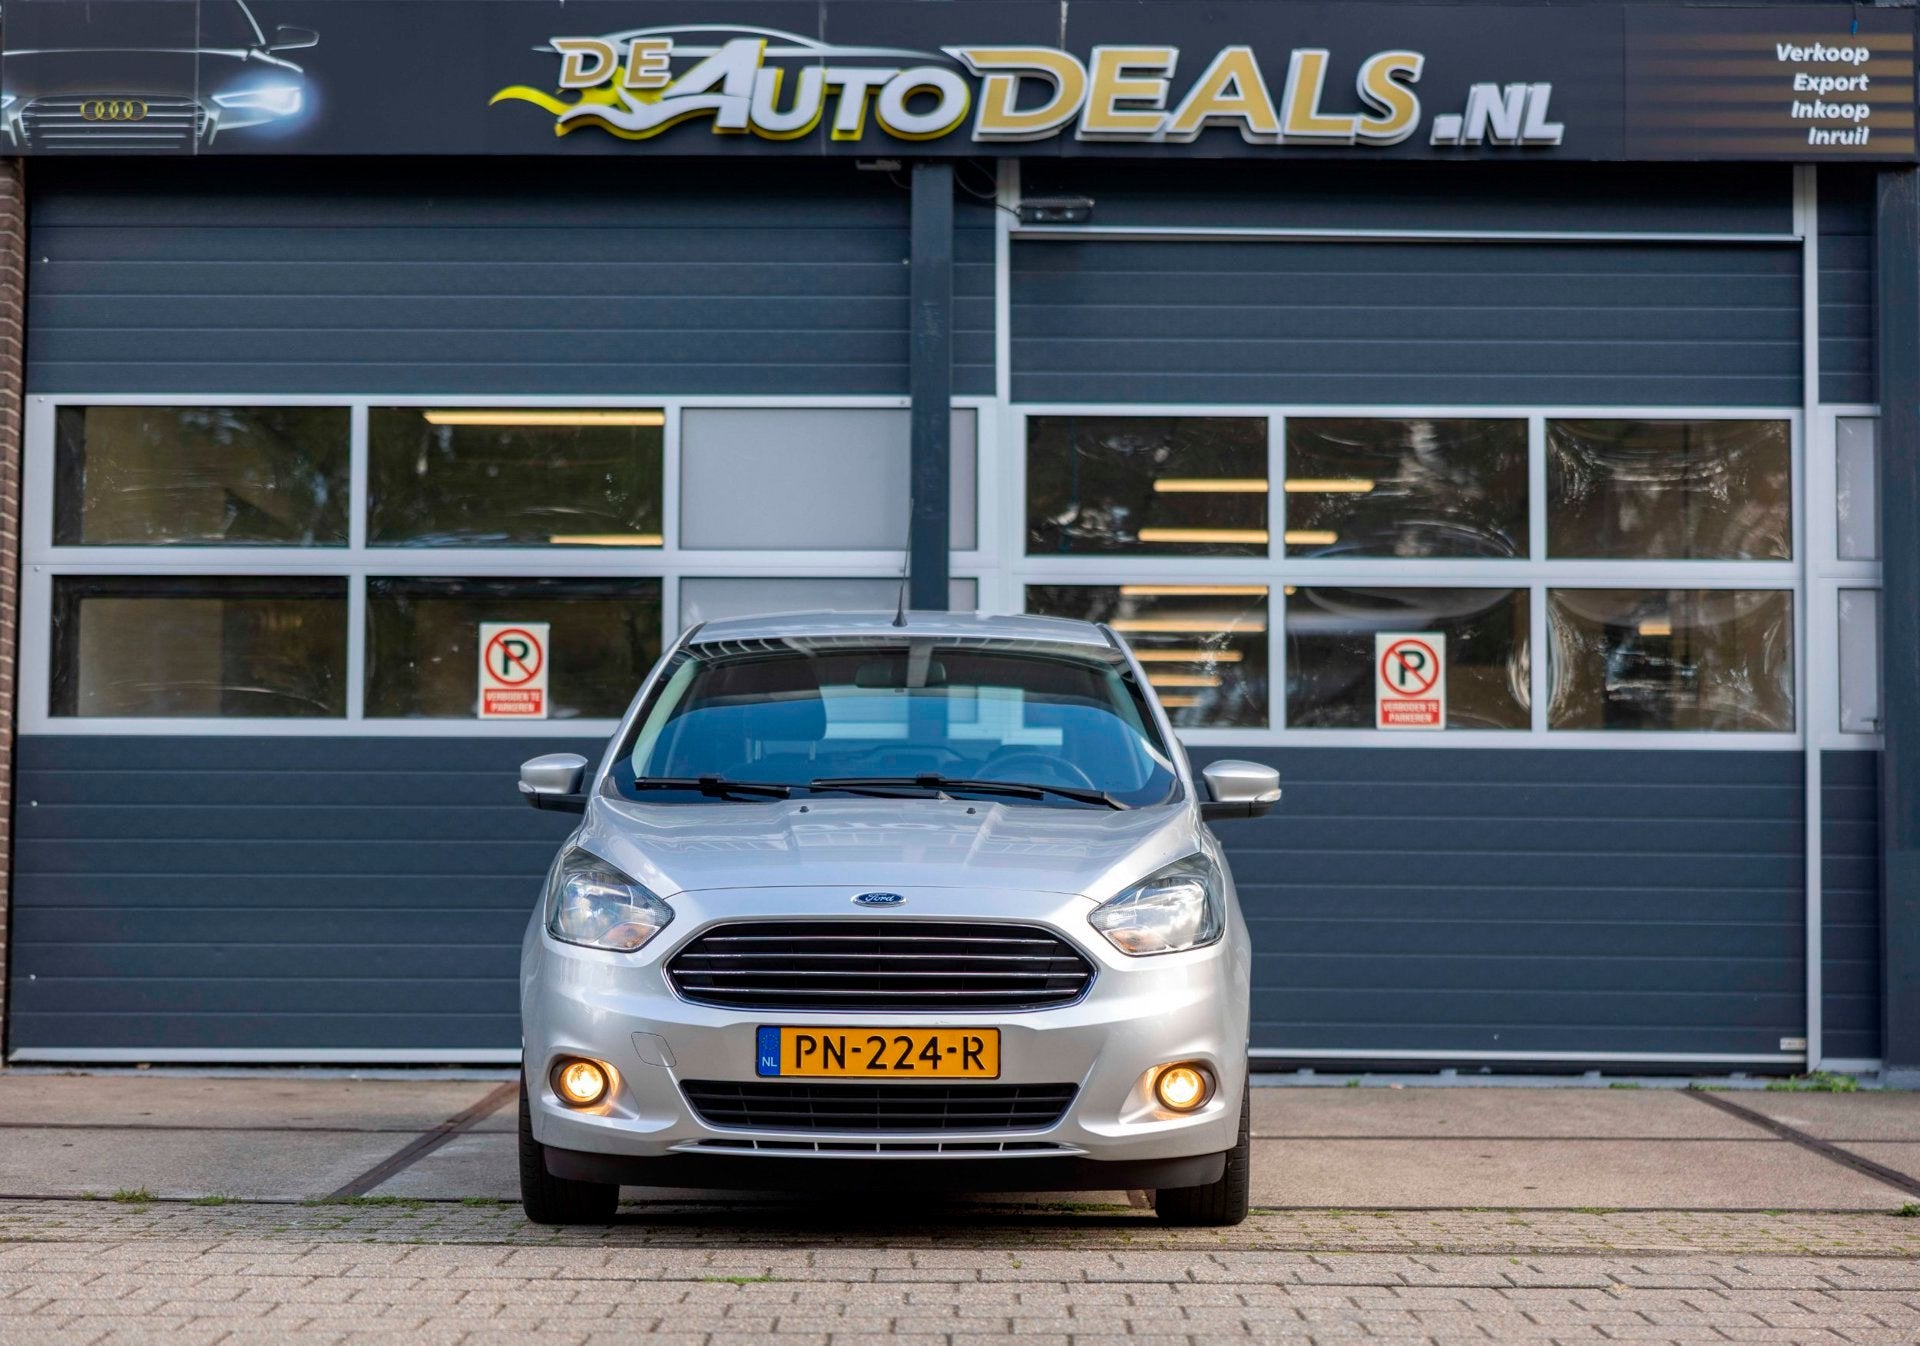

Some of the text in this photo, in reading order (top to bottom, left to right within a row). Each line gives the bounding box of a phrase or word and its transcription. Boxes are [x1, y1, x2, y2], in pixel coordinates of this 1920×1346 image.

[549, 36, 674, 89] DE
[1776, 42, 1870, 66] Verkoop
[1793, 73, 1870, 95] Export
[1791, 99, 1870, 123] Inkoop
[1808, 126, 1870, 145] Inruil
[1383, 701, 1439, 712] VERBODEN TE
[1388, 712, 1432, 723] PARKEREN
[865, 894, 895, 902] Ford
[762, 1057, 777, 1067] NL
[796, 1034, 985, 1070] PN-224-R
